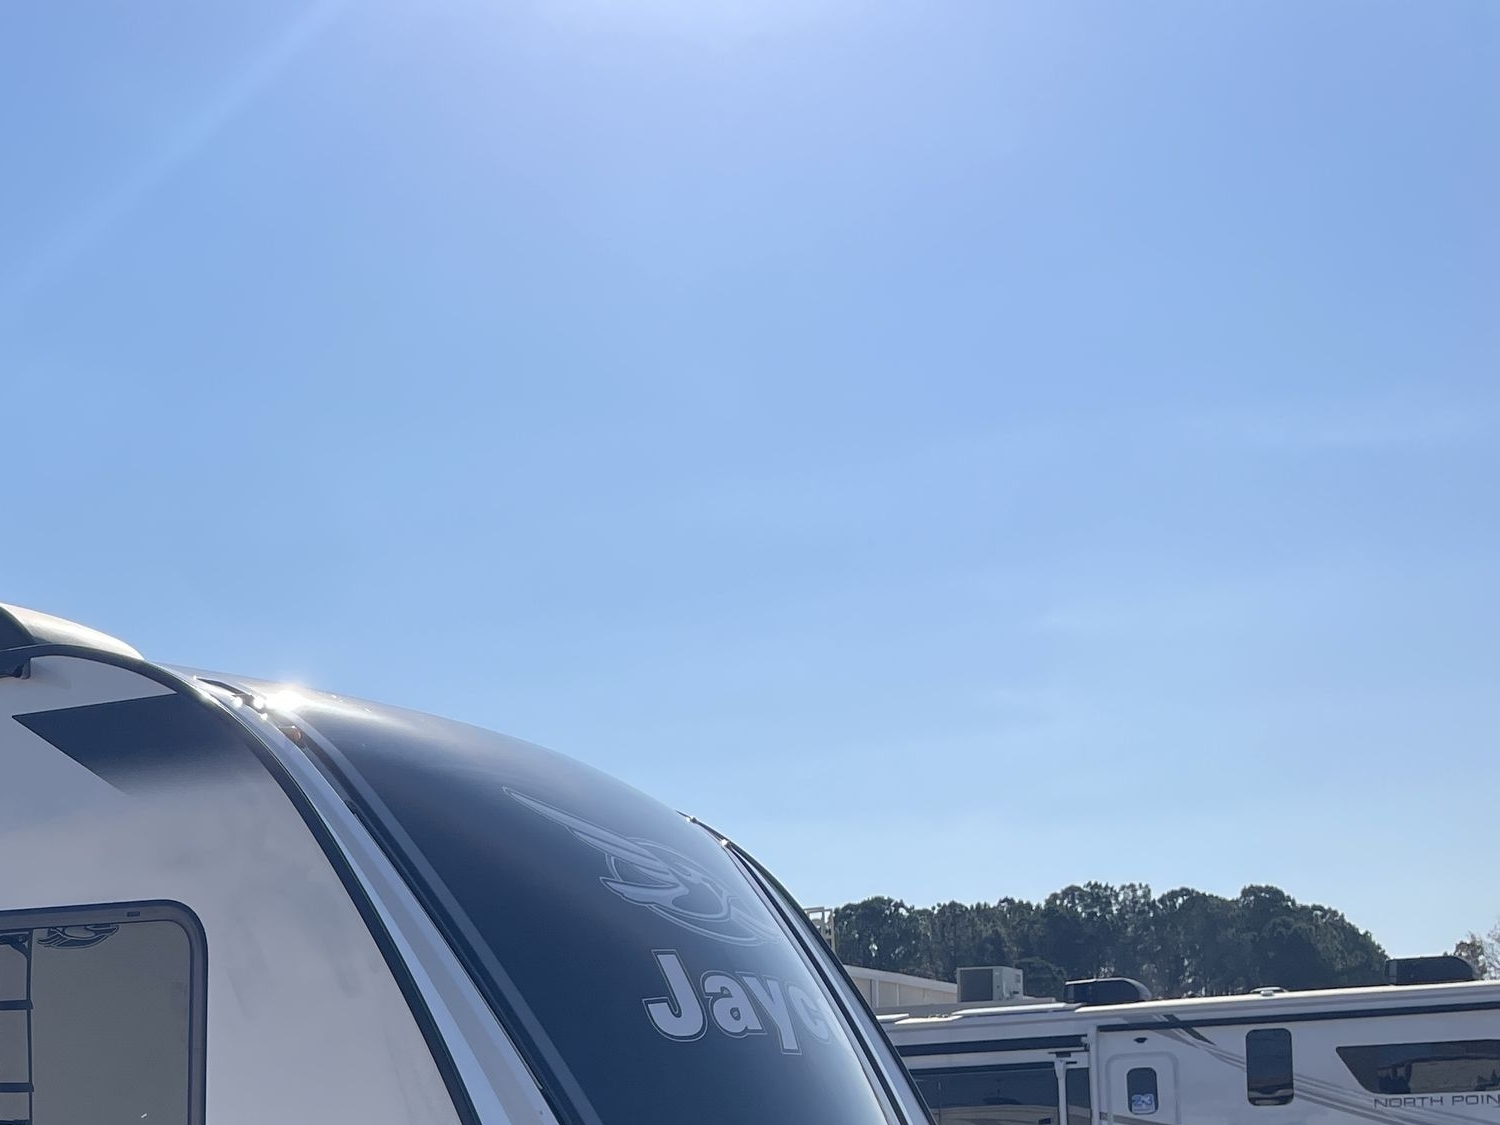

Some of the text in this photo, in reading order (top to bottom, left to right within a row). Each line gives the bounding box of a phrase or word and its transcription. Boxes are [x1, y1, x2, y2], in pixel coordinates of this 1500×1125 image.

[642, 949, 832, 1055] Jayc
[1373, 1094, 1500, 1108] NORTH POIN
